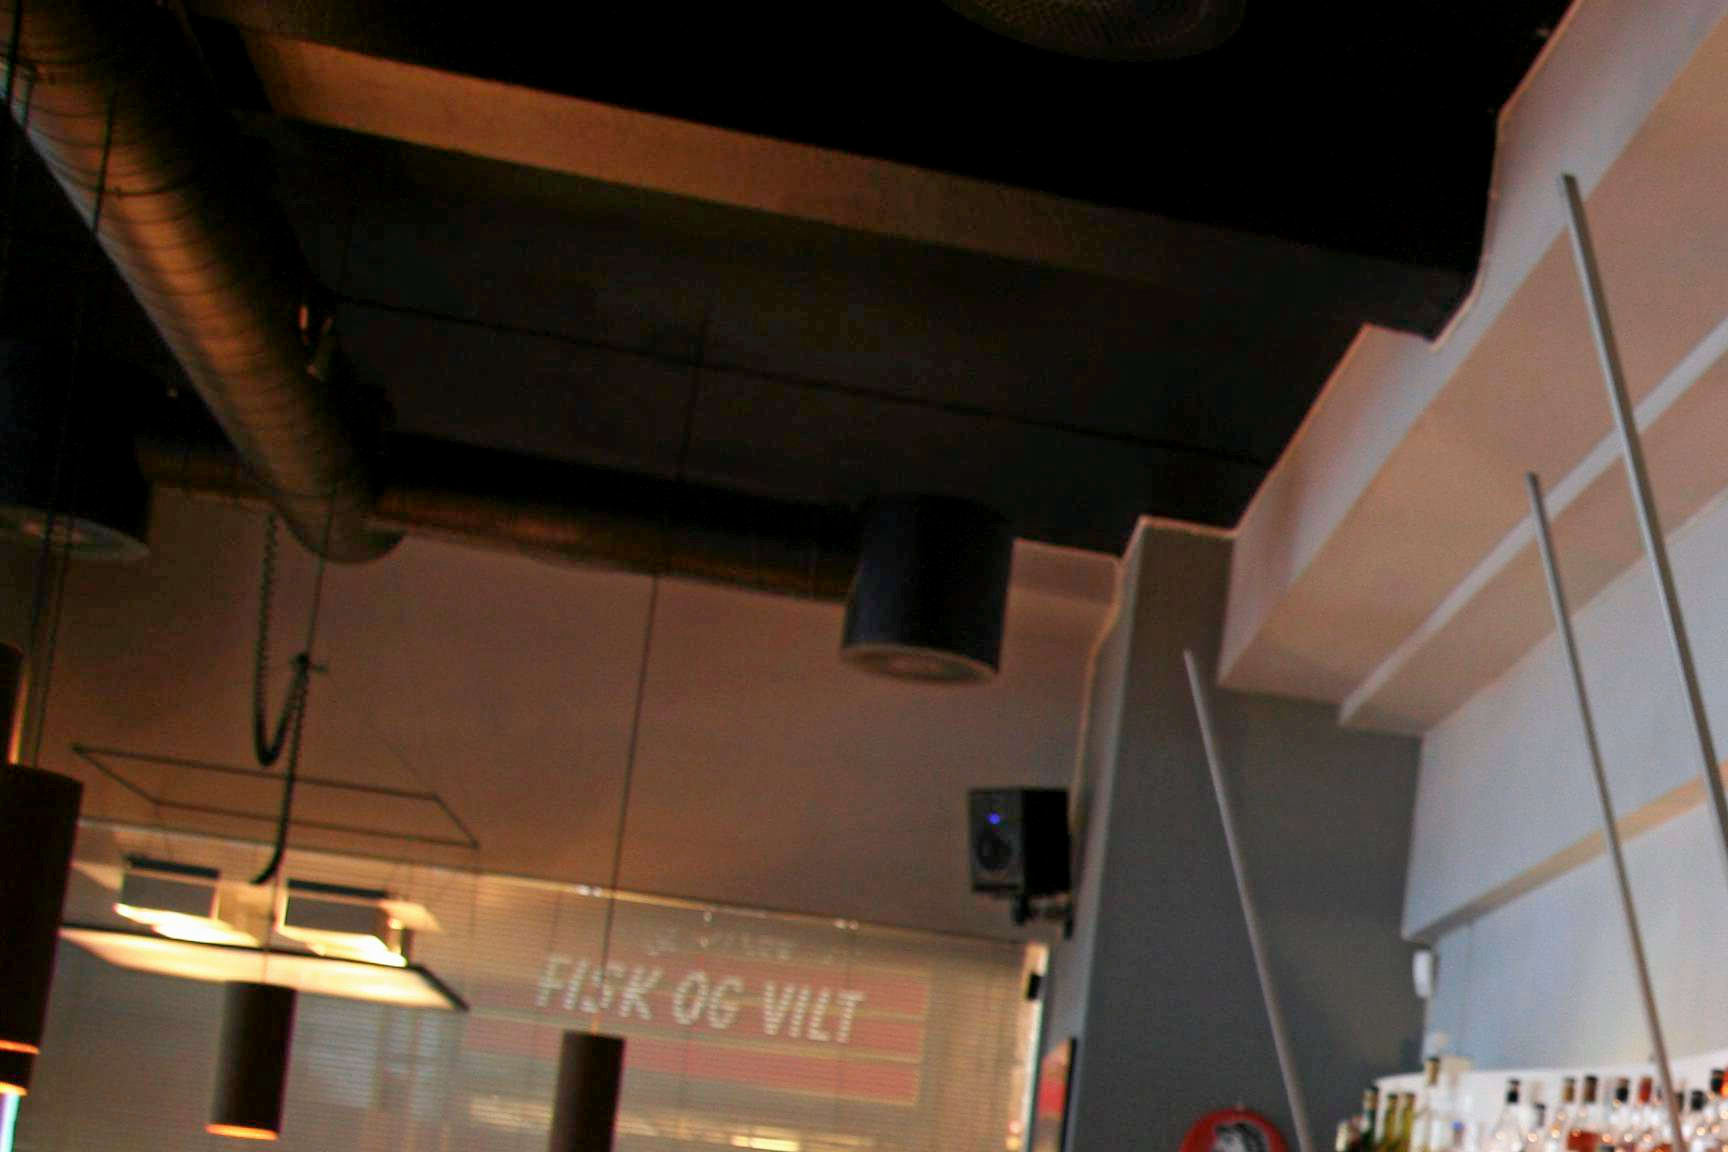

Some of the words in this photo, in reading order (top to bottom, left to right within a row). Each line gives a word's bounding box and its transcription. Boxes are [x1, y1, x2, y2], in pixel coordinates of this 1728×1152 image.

[536, 953, 663, 1021] FISK
[672, 969, 744, 1031] OG
[762, 980, 868, 1044] VILT
